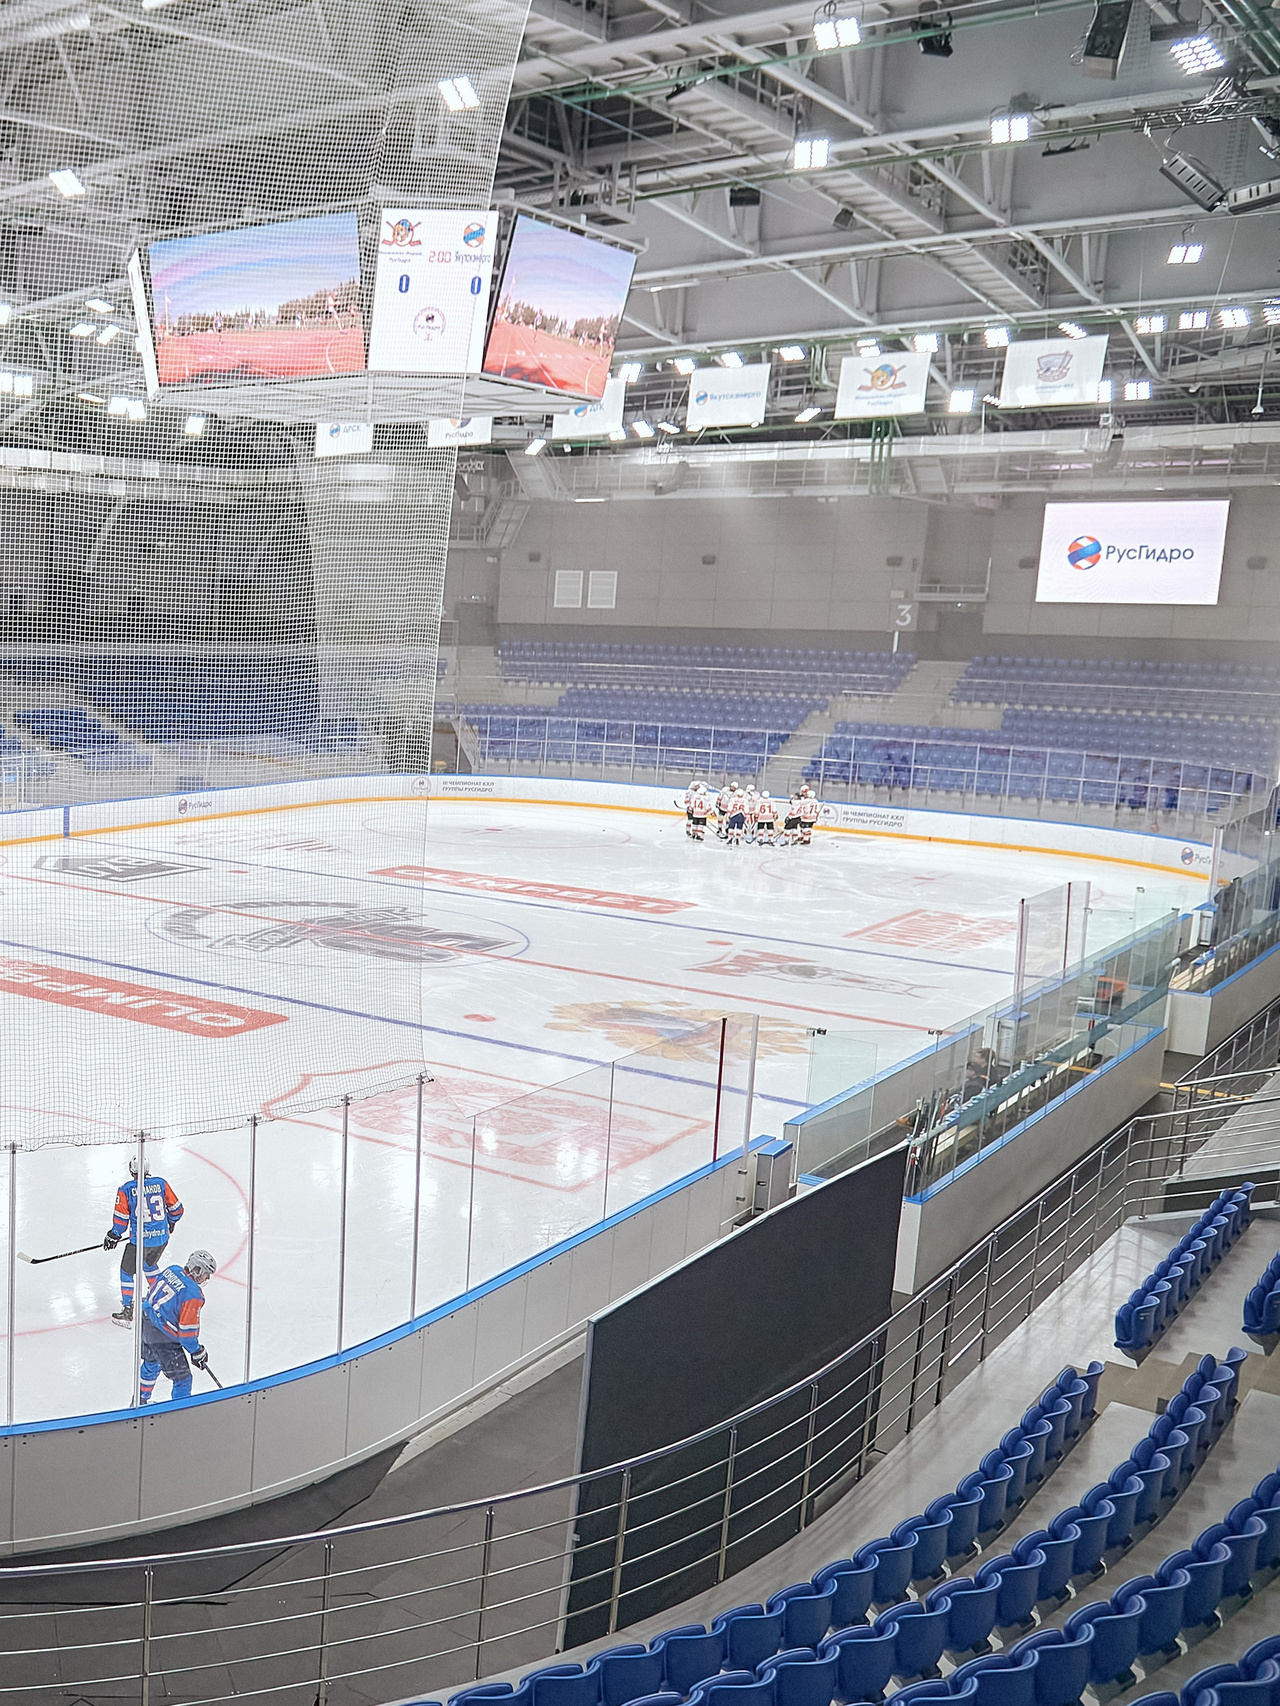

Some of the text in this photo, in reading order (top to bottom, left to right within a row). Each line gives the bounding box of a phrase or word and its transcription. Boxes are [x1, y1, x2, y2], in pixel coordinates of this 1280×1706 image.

[399, 274, 410, 293] 0
[471, 276, 482, 295] 0
[1105, 545, 1195, 564] РусГидро
[892, 604, 912, 627] 3
[760, 804, 772, 814] 61
[850, 811, 889, 820] ЧЕМПИОНАТ
[891, 814, 905, 822] КХЛ
[842, 816, 868, 825] ГРУППЫ
[869, 818, 903, 828] РУСГИДРО
[394, 869, 666, 909] OLIMPBET
[135, 1195, 165, 1223] 43
[148, 1280, 176, 1311] 17
